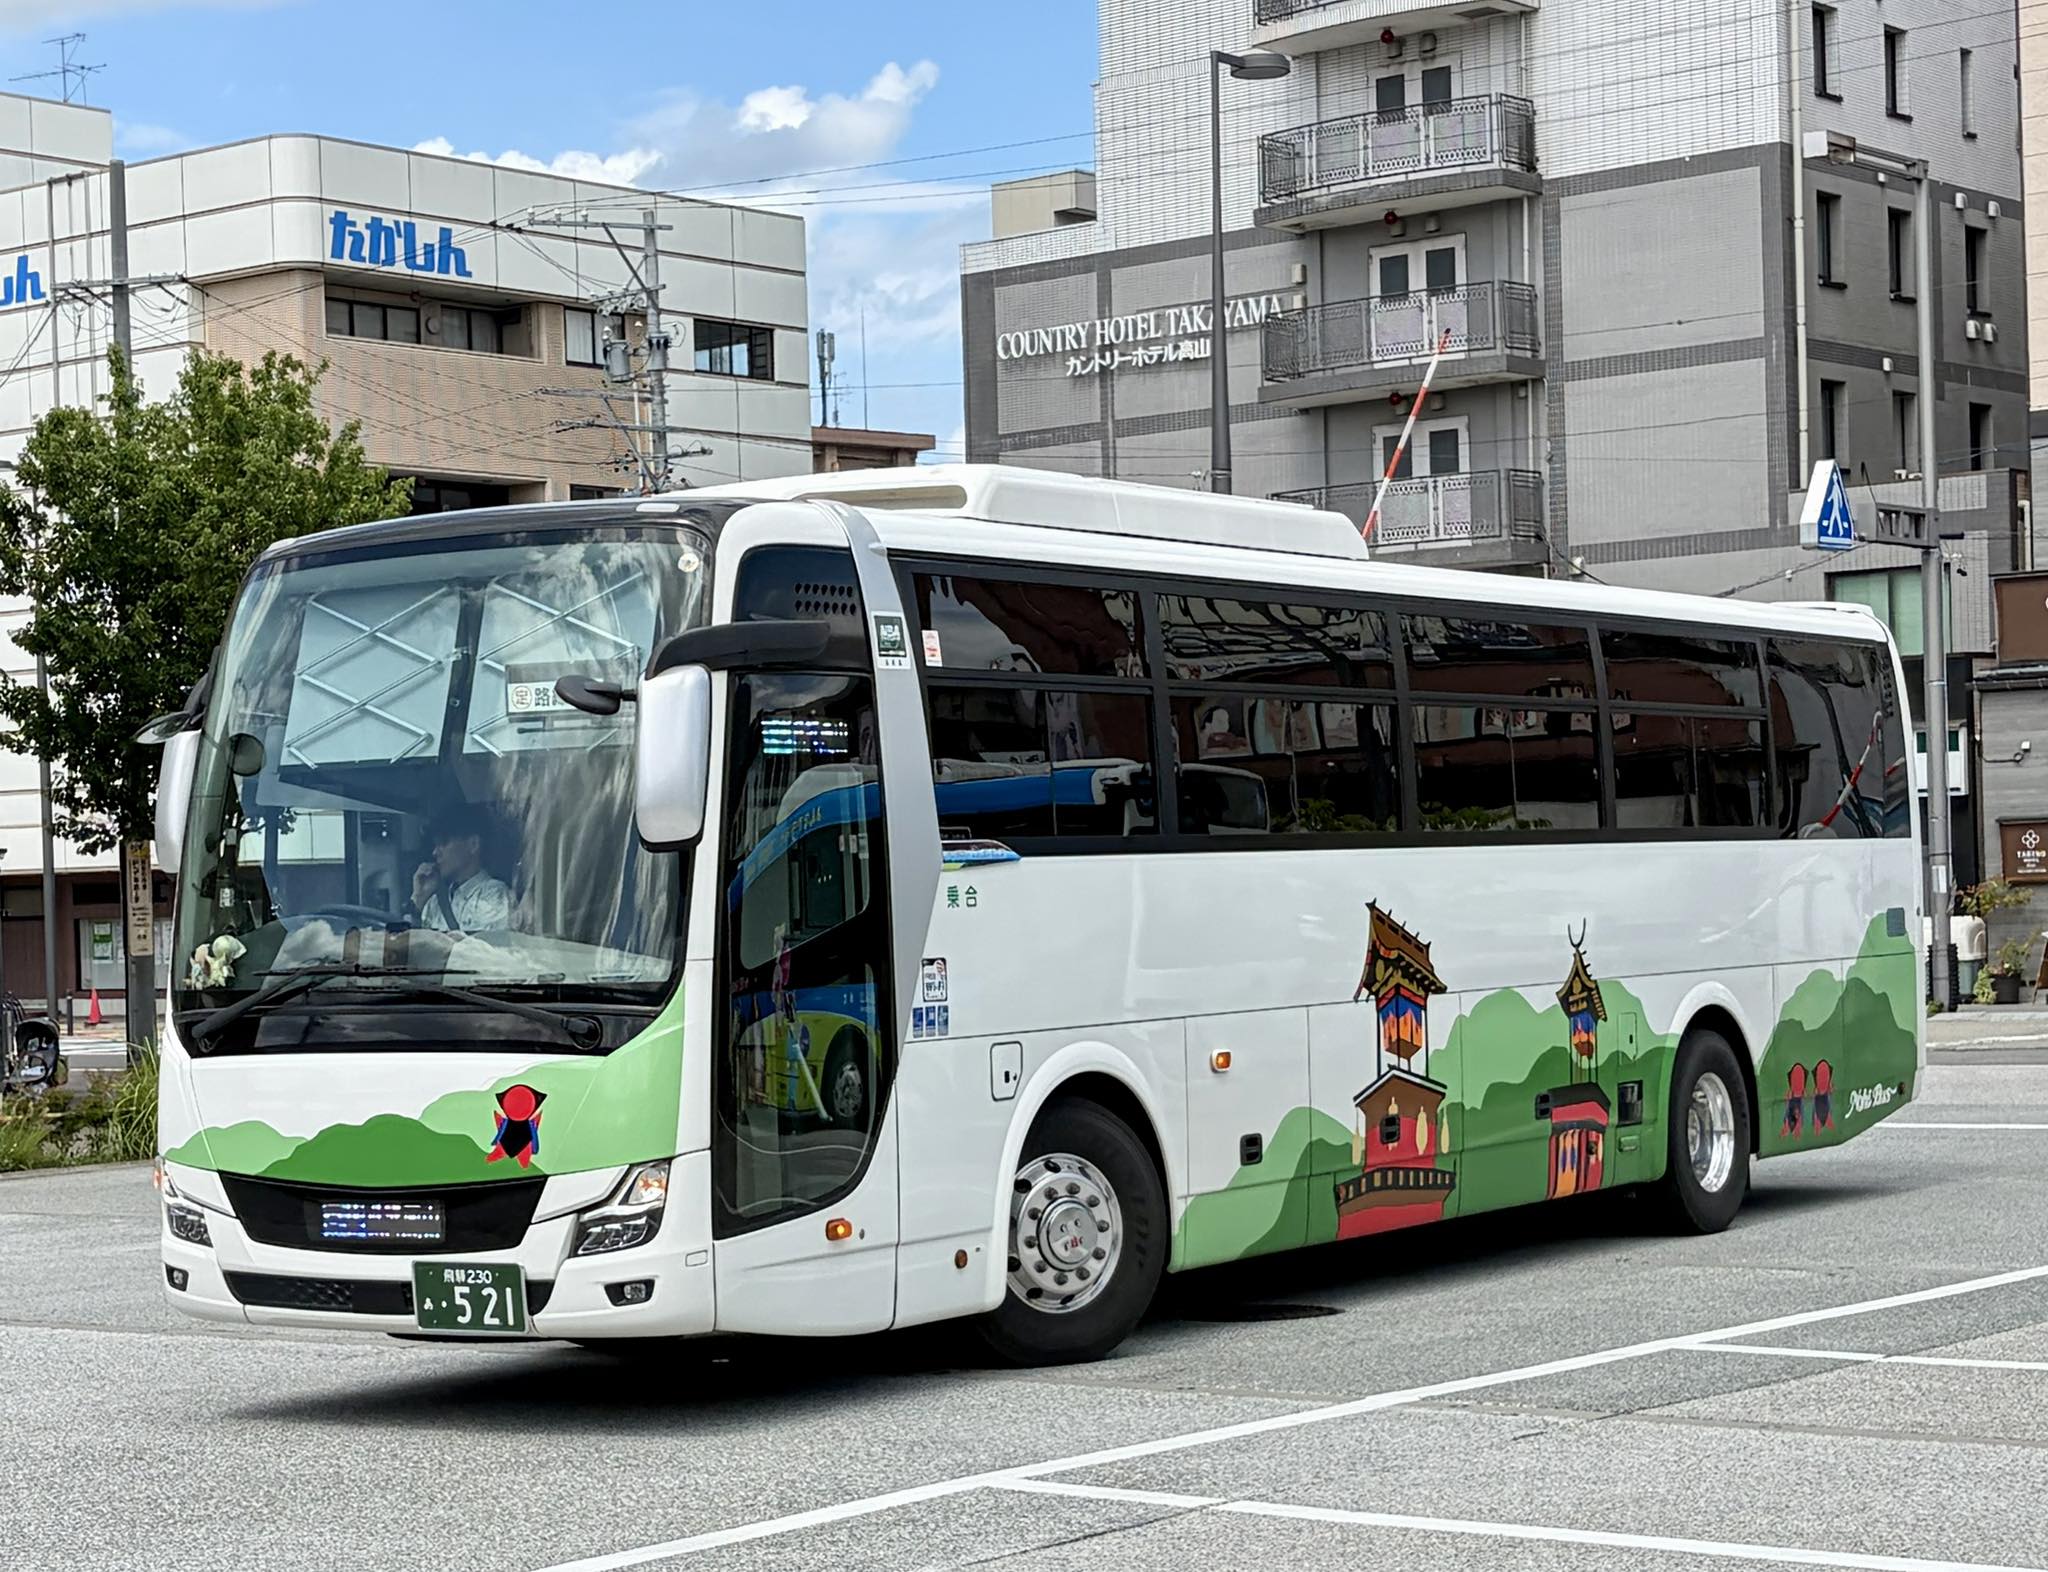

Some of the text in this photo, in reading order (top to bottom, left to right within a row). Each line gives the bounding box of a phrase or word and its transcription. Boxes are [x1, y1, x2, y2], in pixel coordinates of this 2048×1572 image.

[329, 210, 473, 278] たかしん
[997, 321, 1090, 360] COUNTRY
[1095, 311, 1162, 346] HOTEL
[1065, 337, 1211, 377] カントリーホテル高山
[946, 885, 978, 908] 乗合
